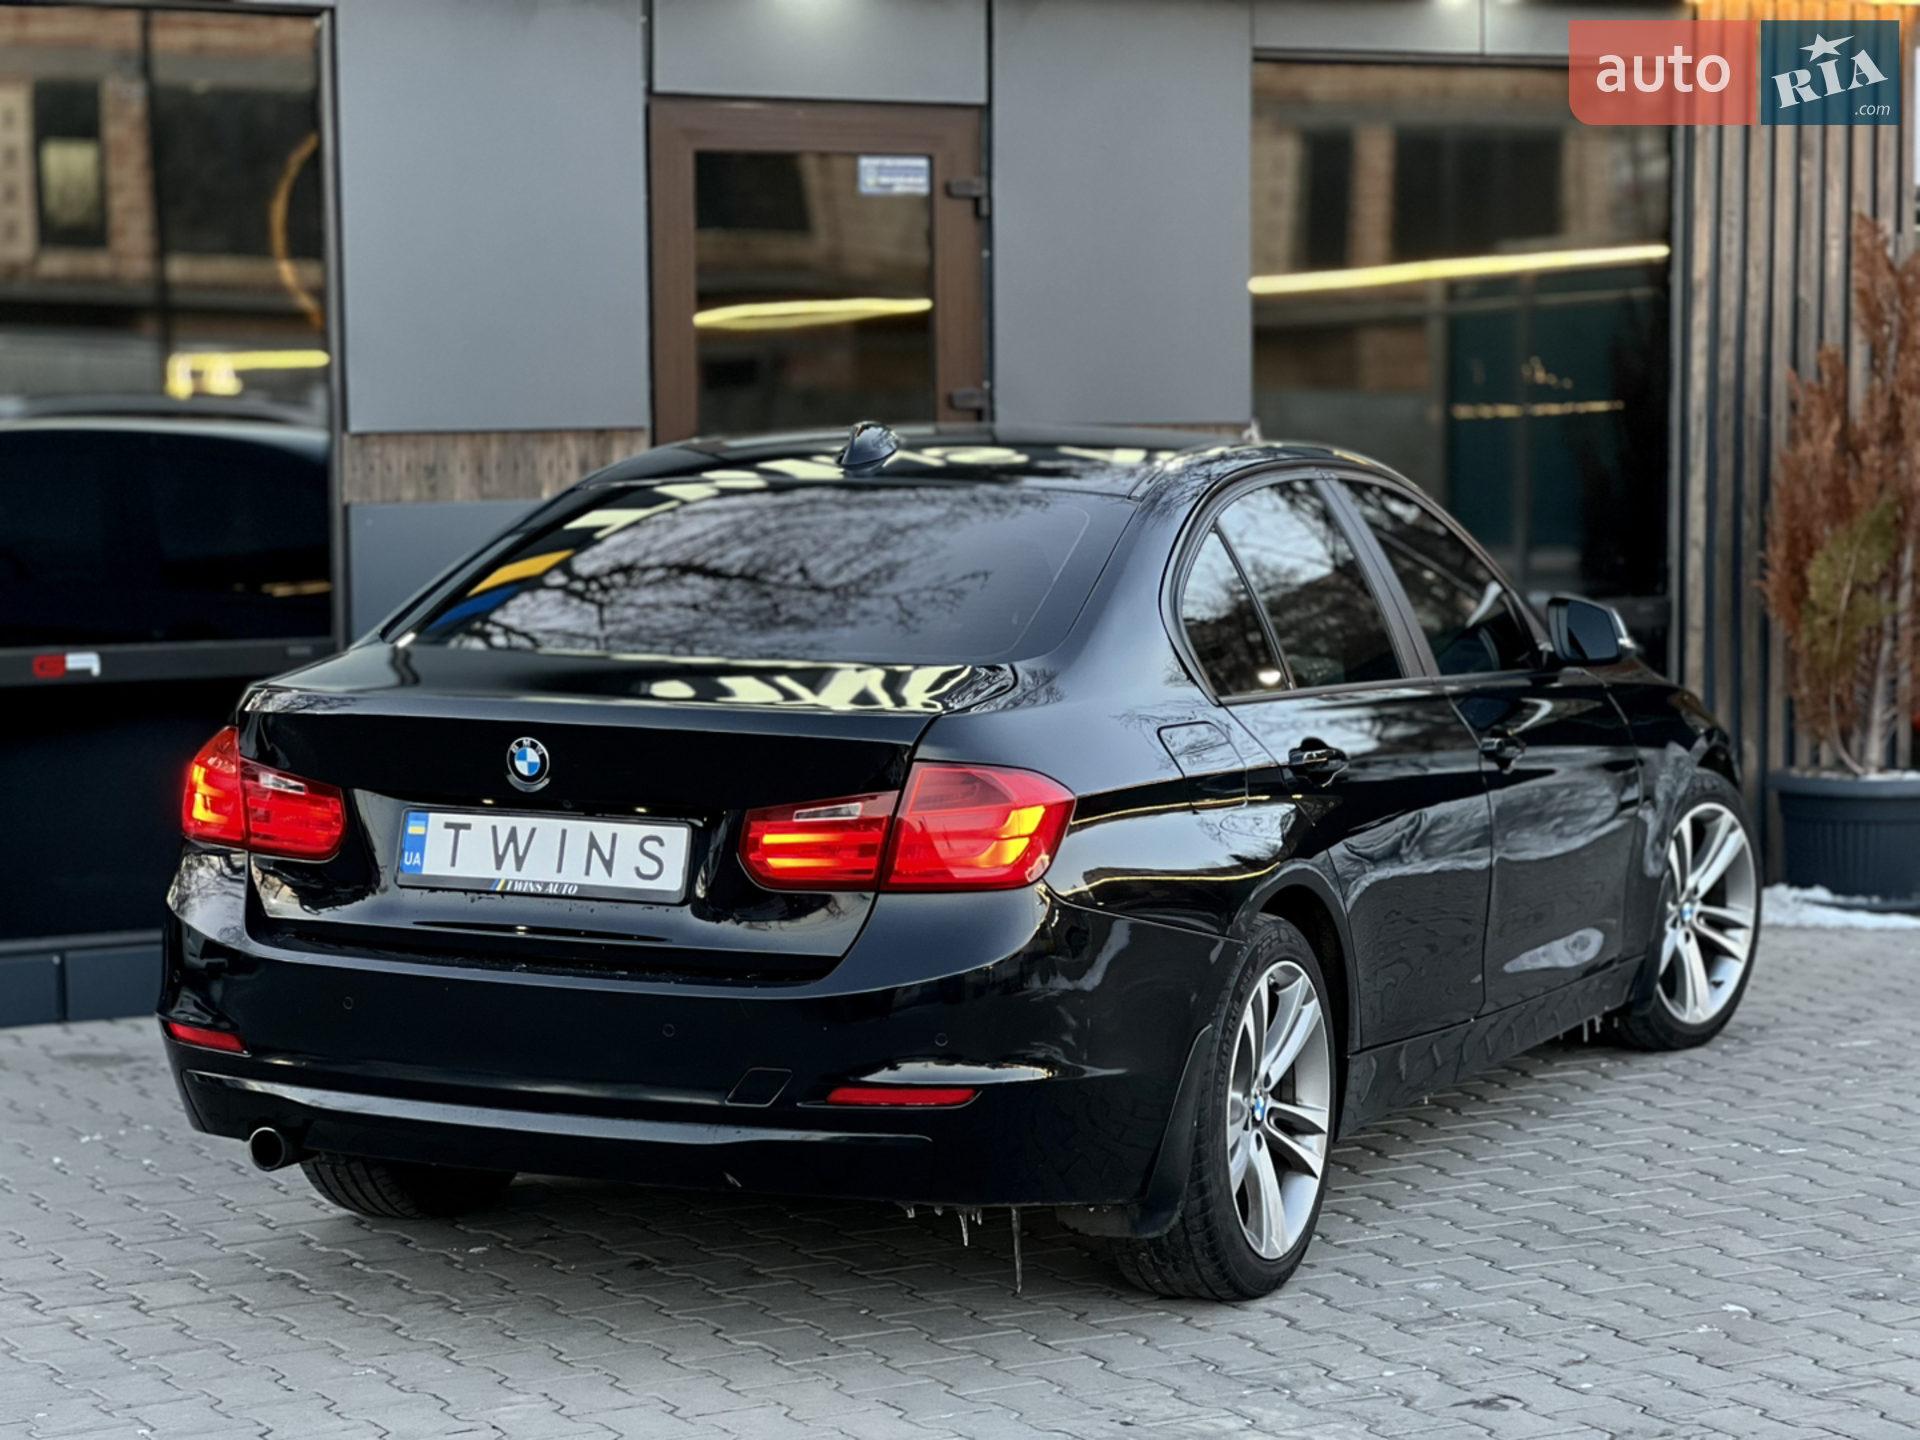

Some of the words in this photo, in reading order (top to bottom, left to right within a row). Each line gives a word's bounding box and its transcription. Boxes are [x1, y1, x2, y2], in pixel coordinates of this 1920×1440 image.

[510, 738, 545, 756] BMW
[403, 851, 422, 867] UA
[443, 821, 666, 882] TWINS
[505, 880, 544, 893] TWINS
[544, 882, 579, 896] AUTO
